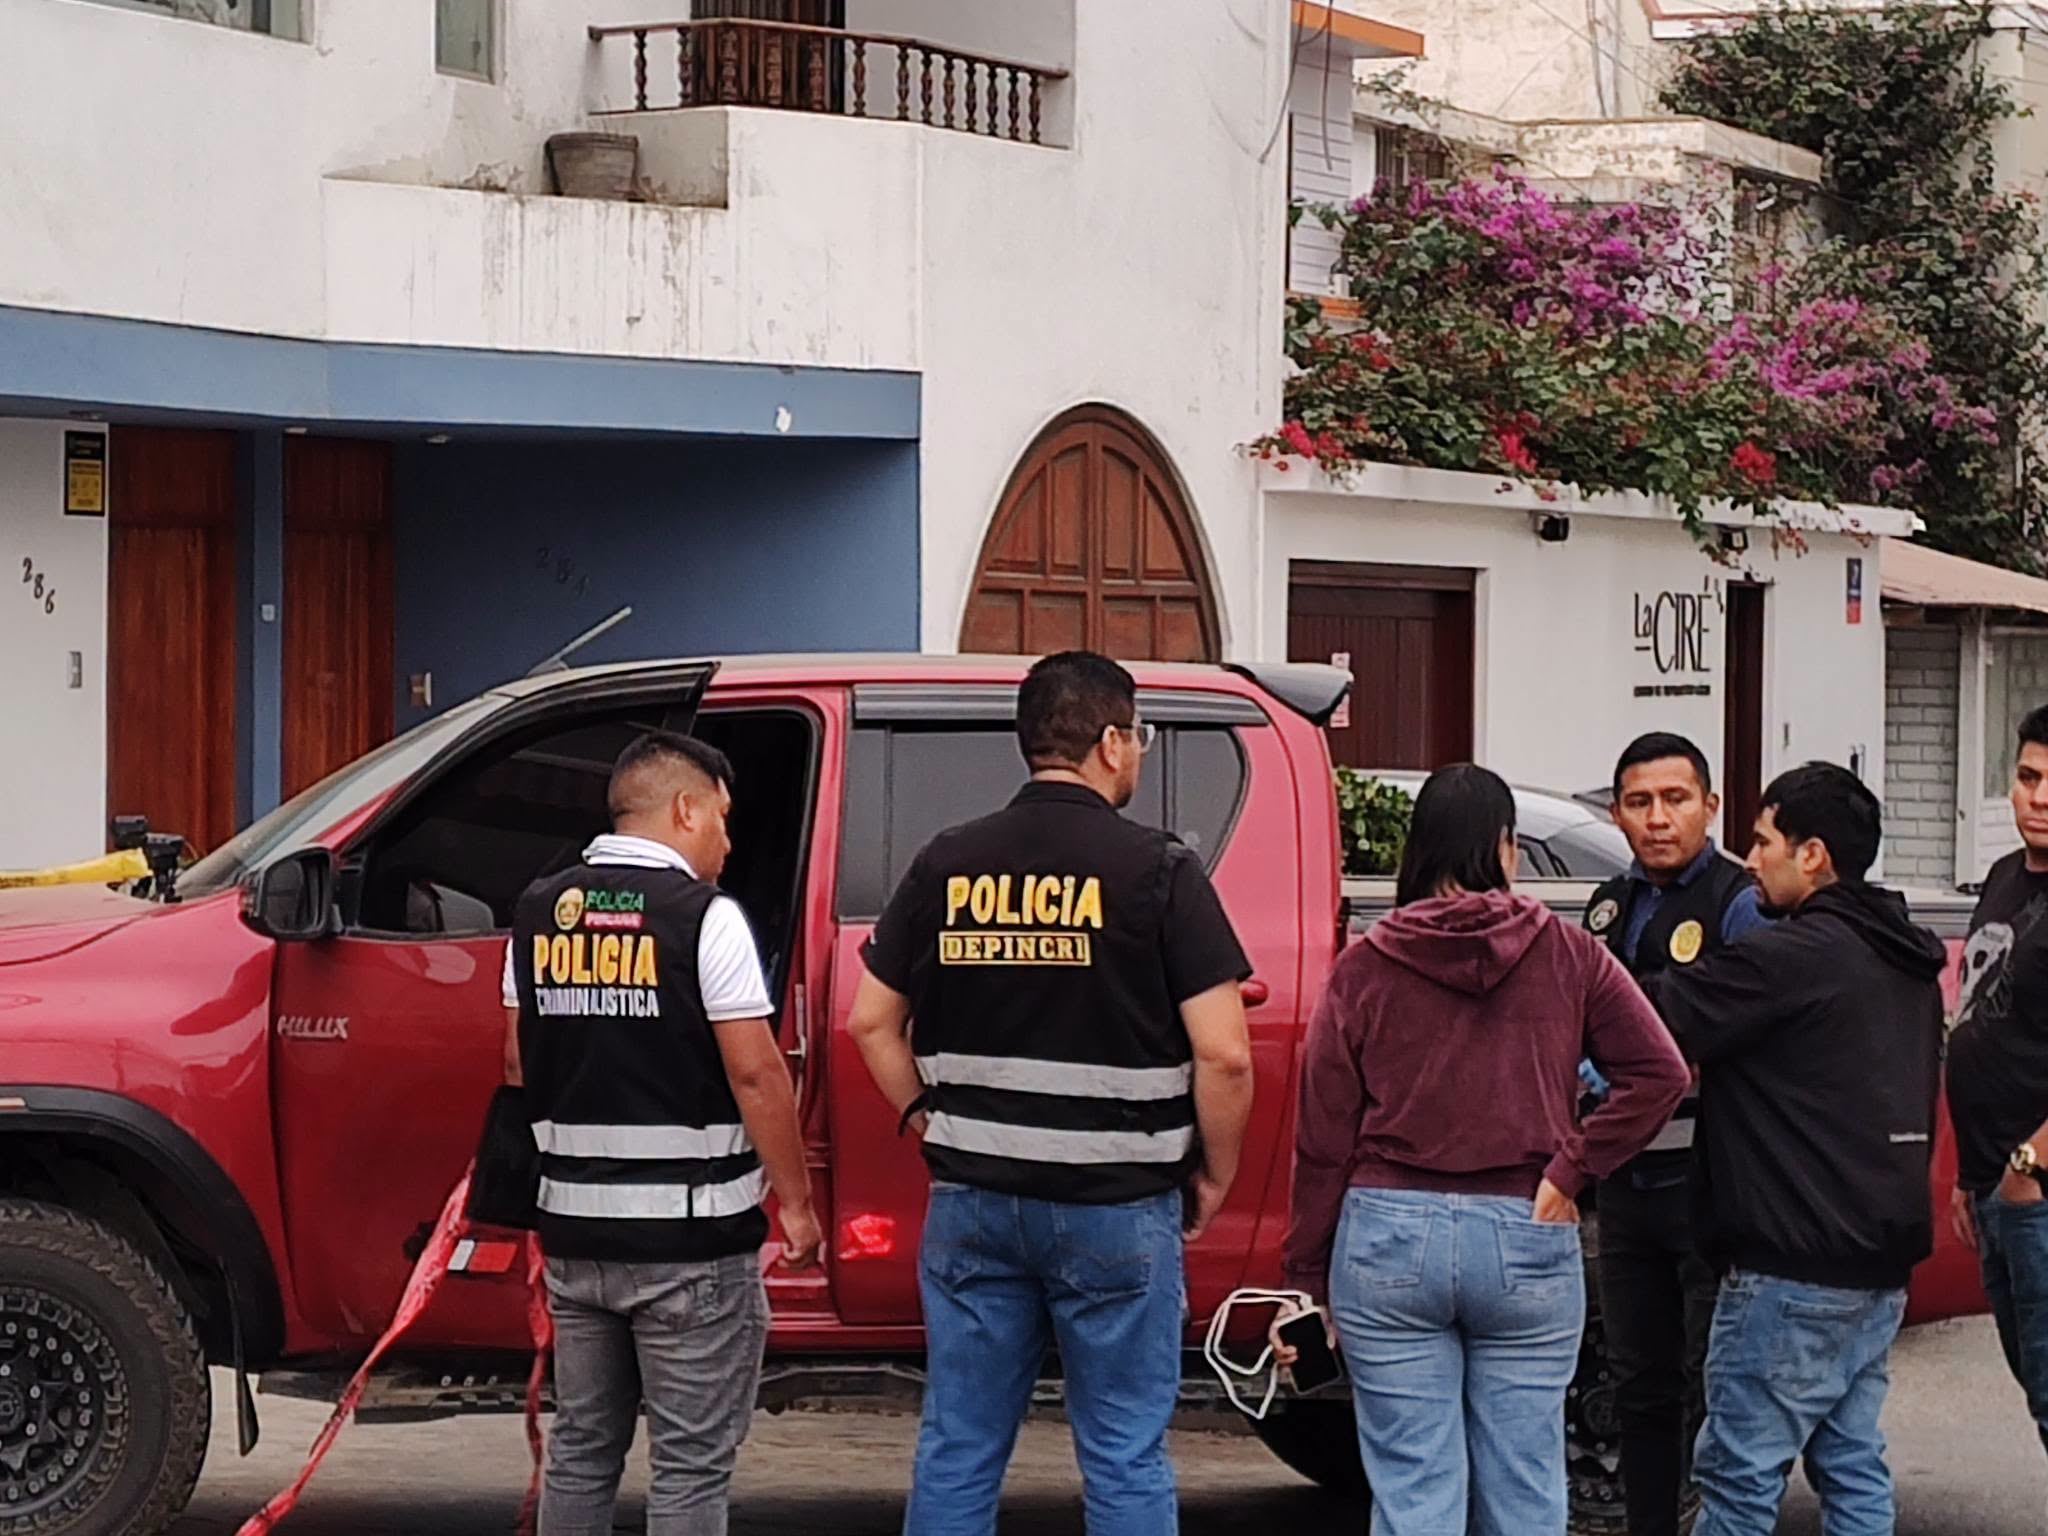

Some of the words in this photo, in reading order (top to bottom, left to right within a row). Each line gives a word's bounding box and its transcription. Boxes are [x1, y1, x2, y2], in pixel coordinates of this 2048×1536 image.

[22, 557, 55, 614] 286
[1634, 592, 1652, 638] La
[944, 936, 1085, 960] DEPINCRI
